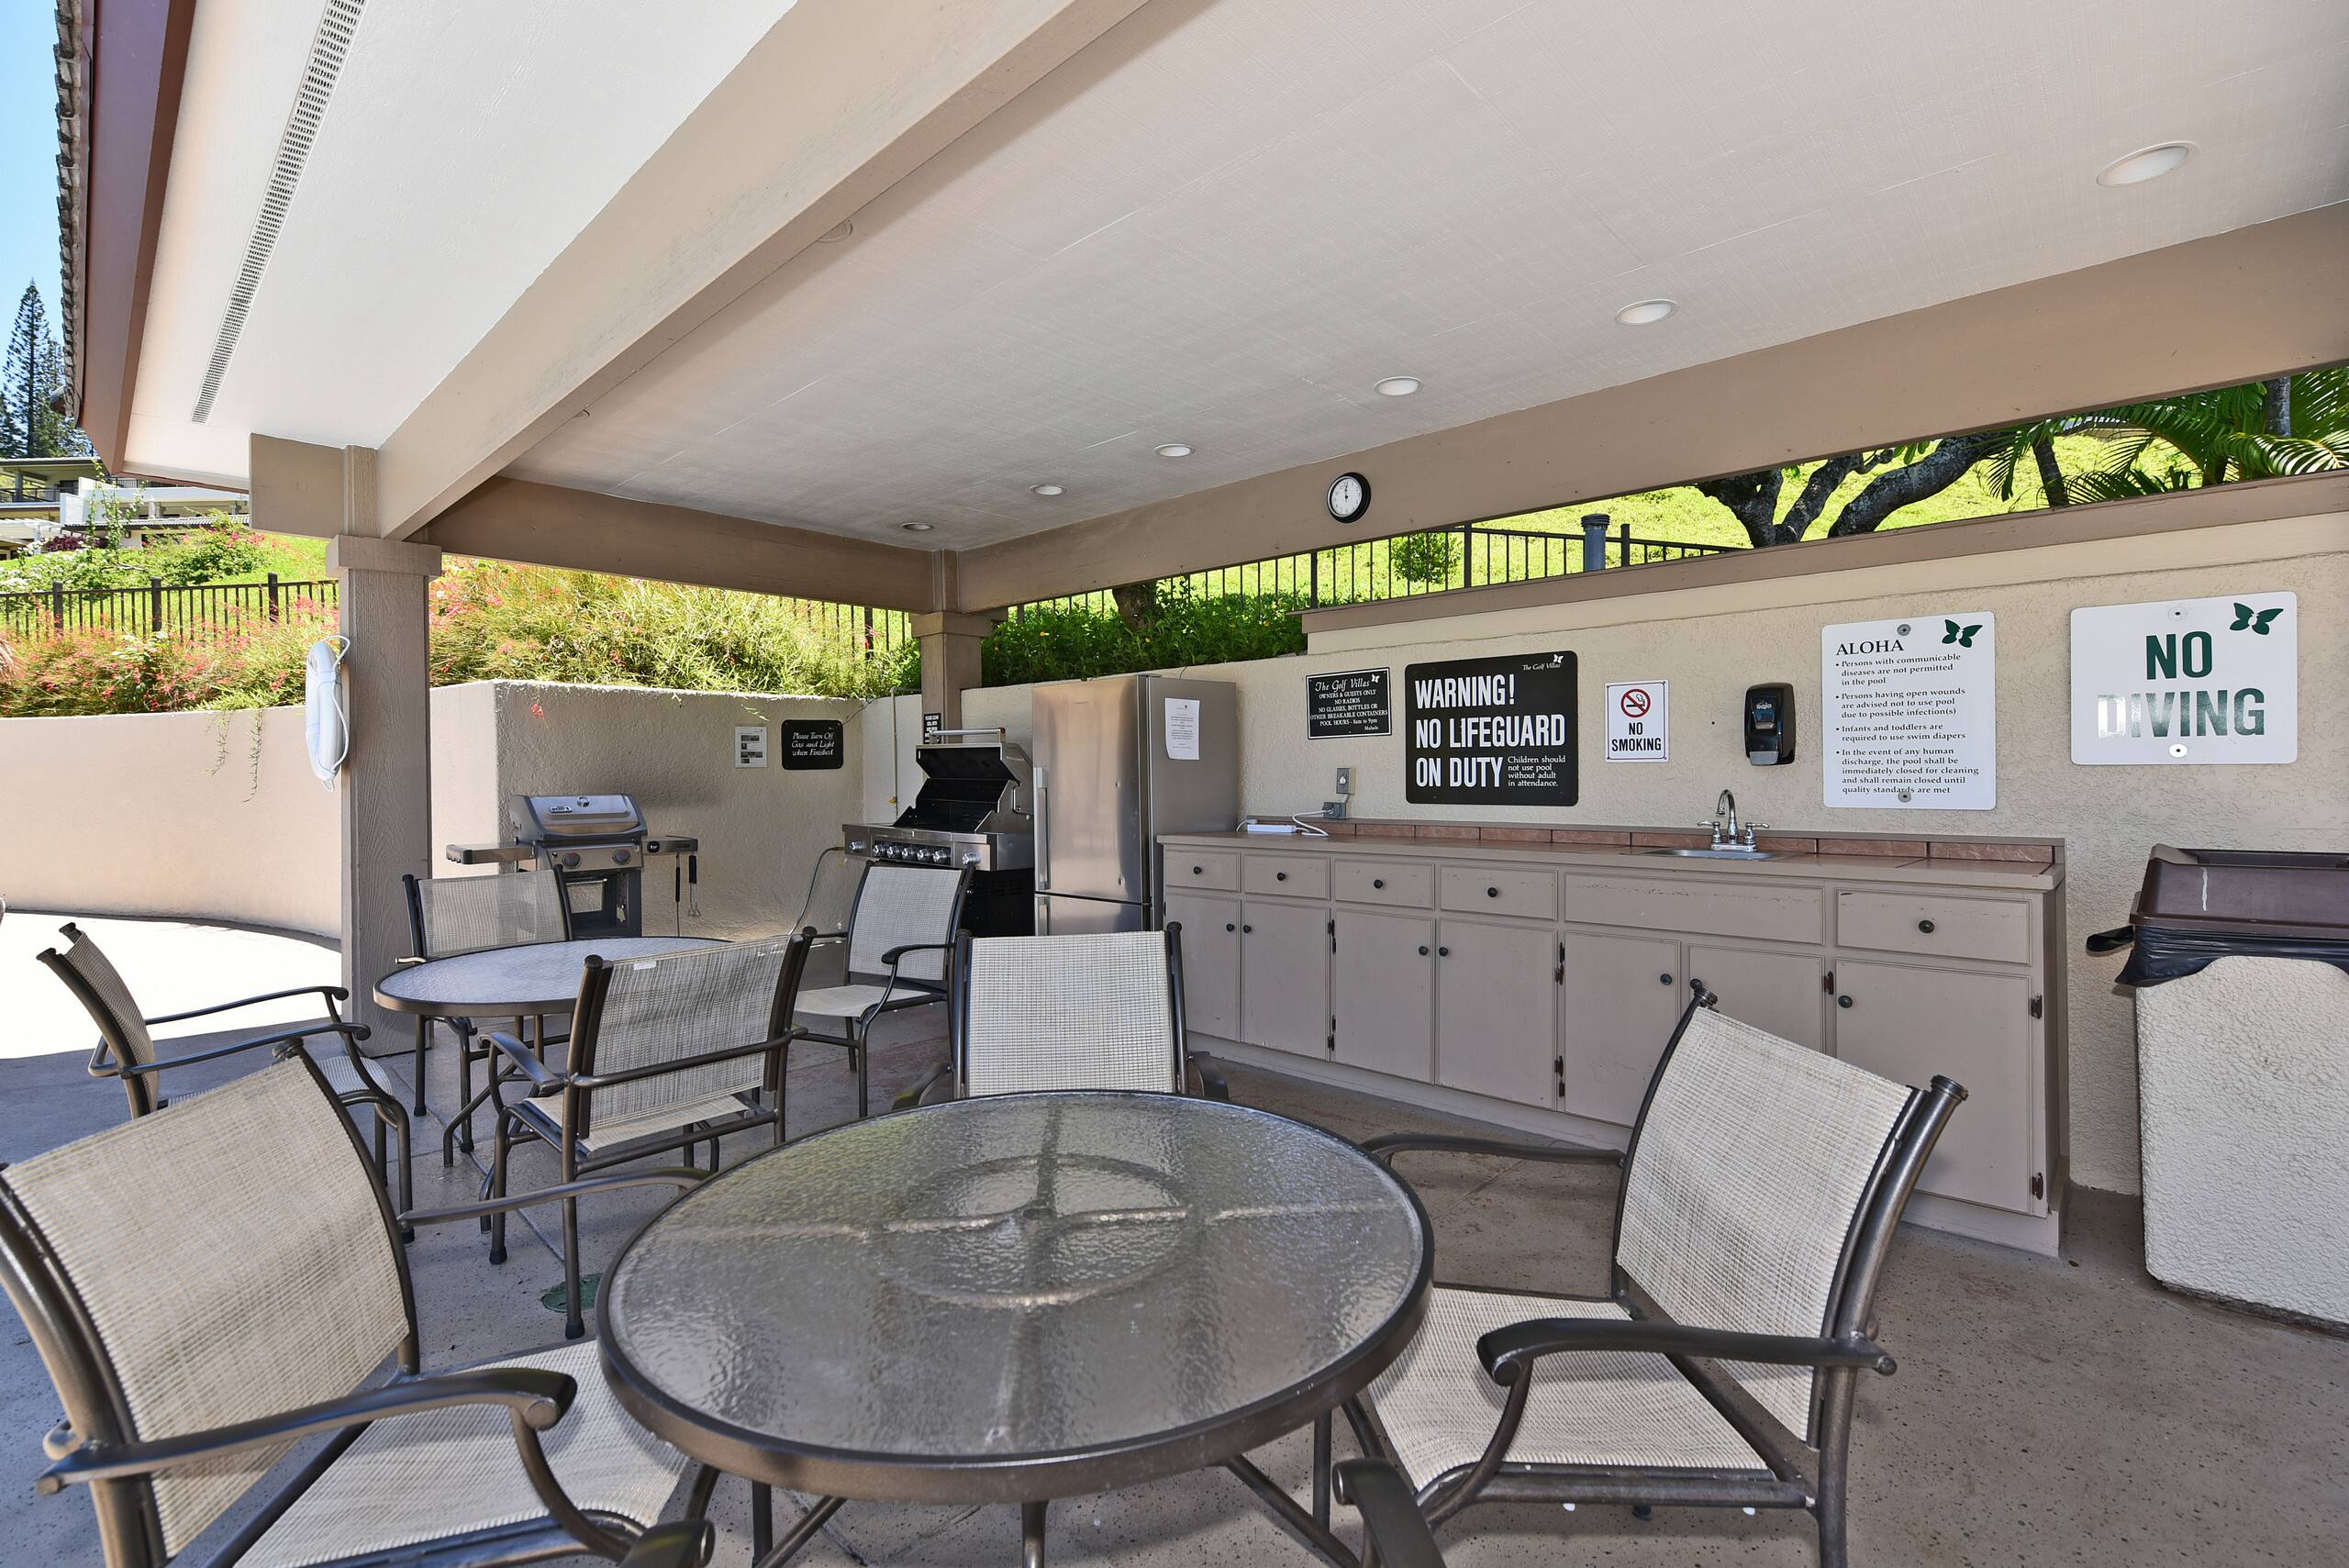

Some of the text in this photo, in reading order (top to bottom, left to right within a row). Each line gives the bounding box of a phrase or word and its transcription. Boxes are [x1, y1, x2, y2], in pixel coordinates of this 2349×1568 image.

[1836, 639, 1904, 655] ALOHA
[1897, 653, 1961, 663] communicable
[2145, 630, 2212, 680] NO
[1909, 663, 1953, 674] permitted
[1315, 678, 1369, 692] The Golf Villas
[1868, 677, 1886, 686] pool
[1415, 674, 1514, 708] WARNING!
[1931, 687, 1965, 695] wounds
[1936, 698, 1954, 706] pool
[1870, 709, 1904, 718] possible
[1907, 707, 1956, 716] infection(s)
[2098, 688, 2265, 739] DIVING
[1416, 714, 1565, 748] NO LIFEGUARD
[1629, 722, 1642, 735] NO
[824, 732, 835, 740] Off
[1842, 734, 1876, 743] required
[819, 740, 834, 749] Light
[1611, 738, 1661, 751] SMOKING
[1542, 755, 1565, 763] should
[1903, 758, 1920, 766] pool
[1416, 757, 1503, 787] ON DUTY
[1536, 763, 1553, 773] pool
[1842, 767, 1893, 775] immediately
[1941, 767, 1979, 775] cleaning
[1538, 771, 1556, 779] adult
[1842, 786, 1870, 795] quality
